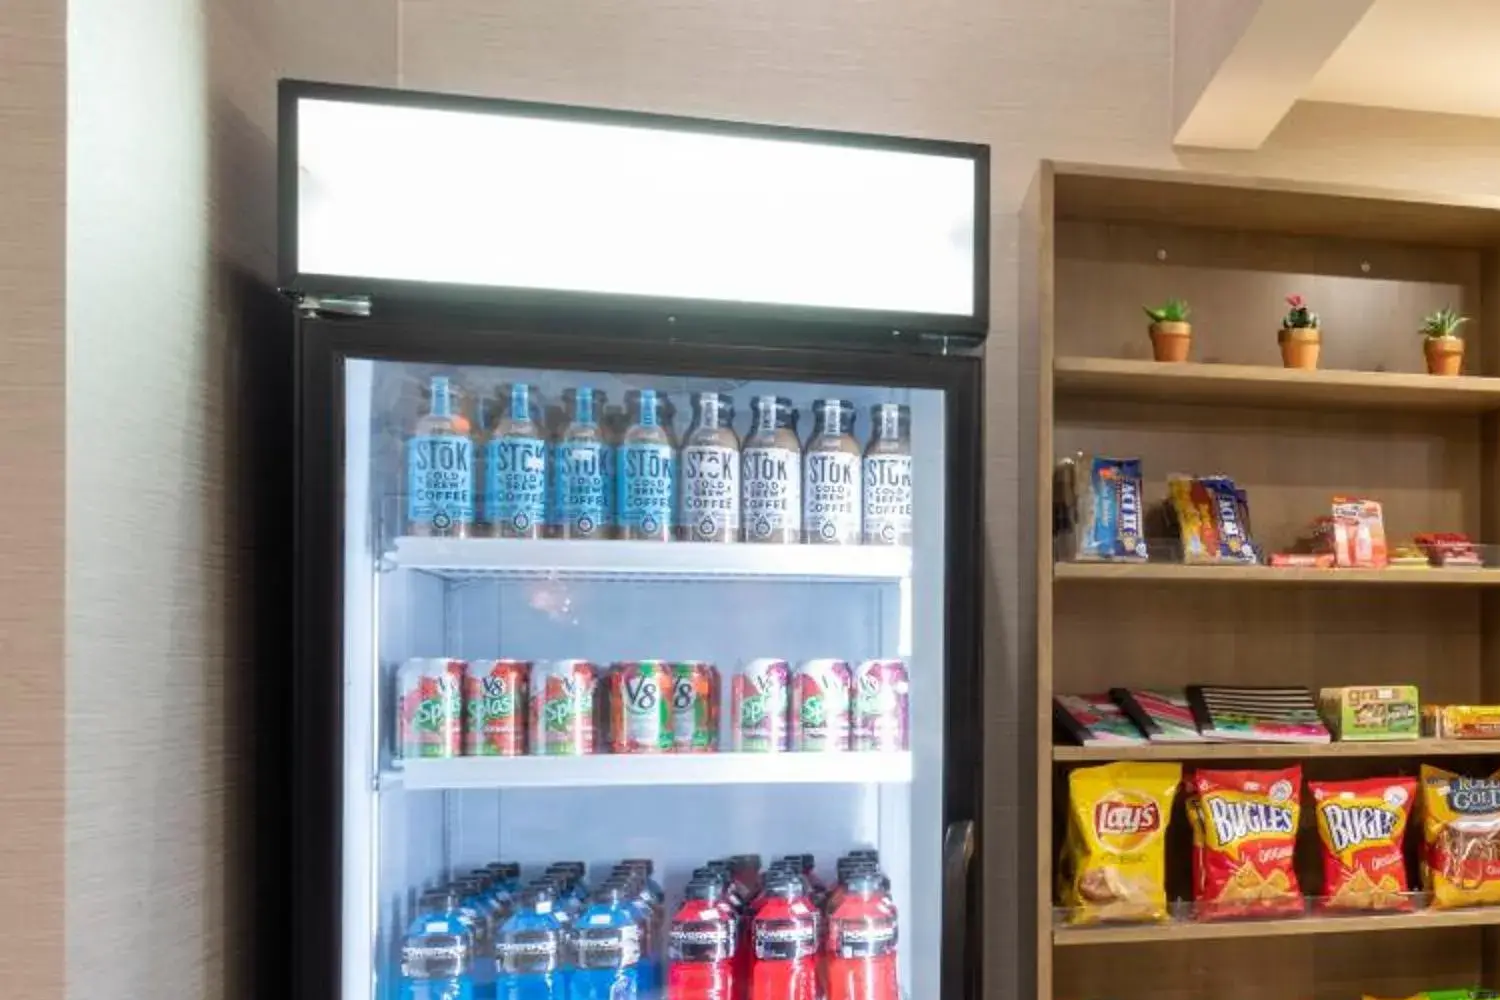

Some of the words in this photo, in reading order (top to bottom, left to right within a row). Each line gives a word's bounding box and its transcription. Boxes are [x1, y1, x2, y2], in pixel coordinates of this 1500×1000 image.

[416, 490, 468, 502] COFFEE
[482, 676, 505, 696] V8
[625, 675, 657, 709] V8
[1208, 797, 1294, 847] BUGLES
